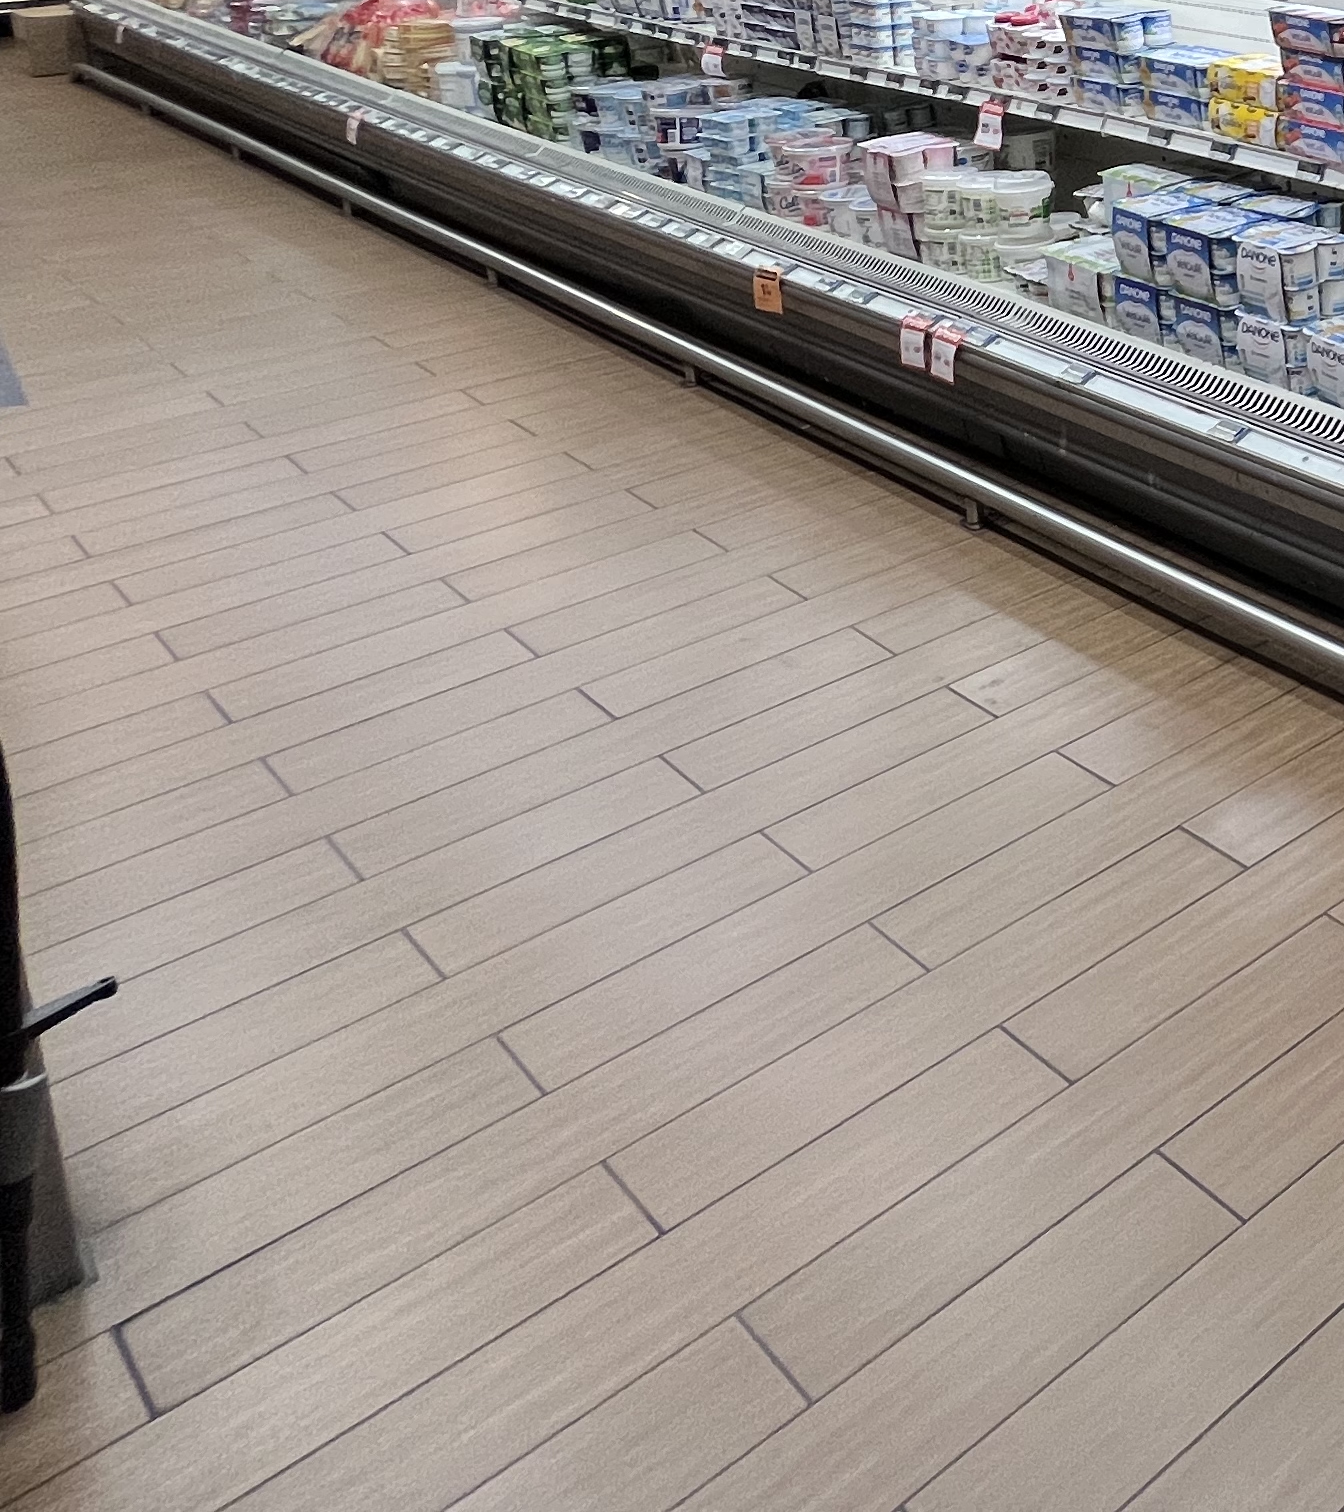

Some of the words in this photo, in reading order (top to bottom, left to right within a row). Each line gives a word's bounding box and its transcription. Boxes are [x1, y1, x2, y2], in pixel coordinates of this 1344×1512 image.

[1171, 232, 1202, 250] DANONE
[1241, 248, 1276, 267] DANONE
[1119, 284, 1150, 302] DANONE
[1180, 303, 1212, 322] DANONE
[1241, 322, 1280, 342] DANONE
